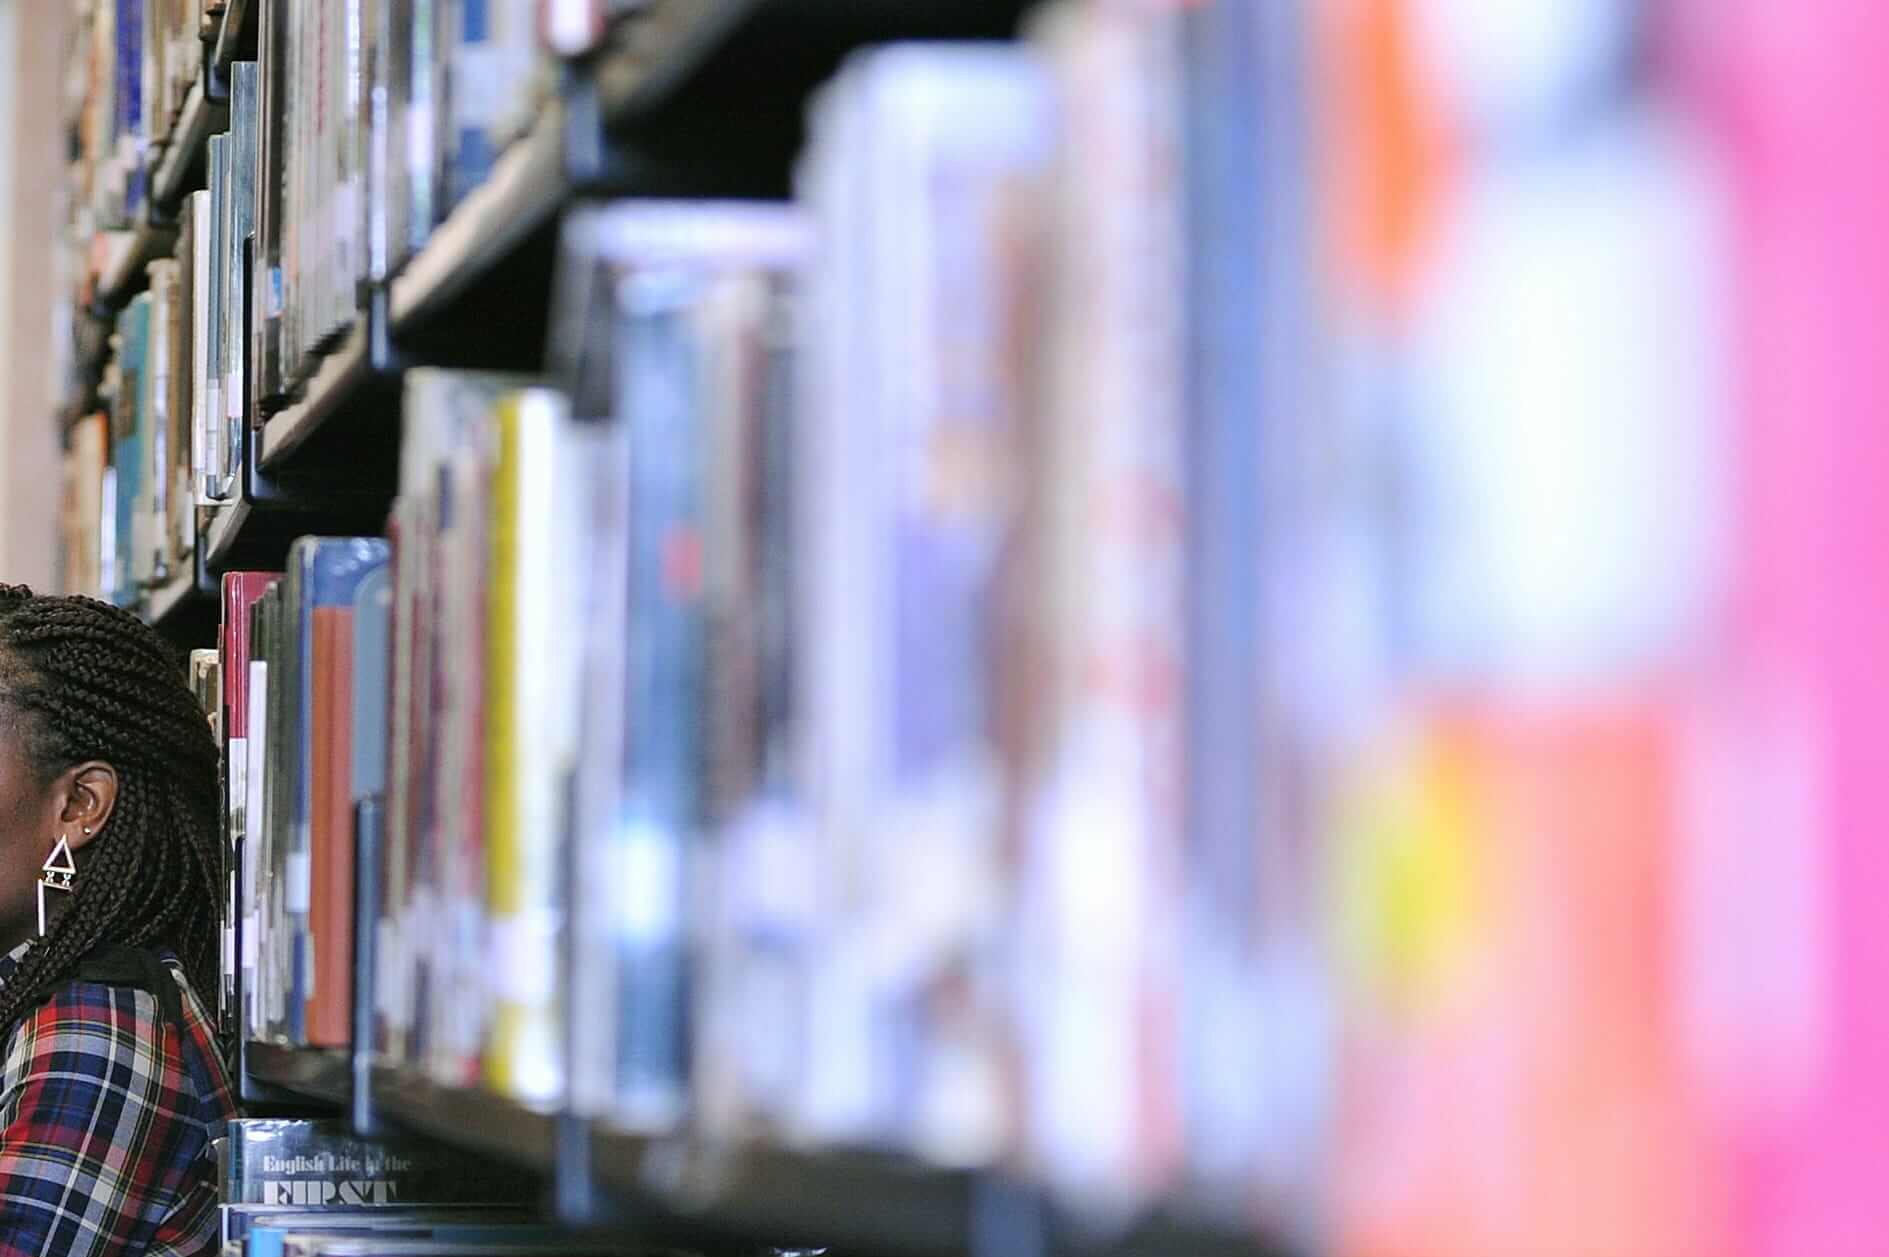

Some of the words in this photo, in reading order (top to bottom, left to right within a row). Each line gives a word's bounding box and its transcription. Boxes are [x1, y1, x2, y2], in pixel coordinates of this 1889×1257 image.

[263, 1154, 325, 1175] English
[327, 1154, 361, 1172] Life
[383, 1154, 412, 1172] the
[263, 1180, 398, 1206] FIRST
